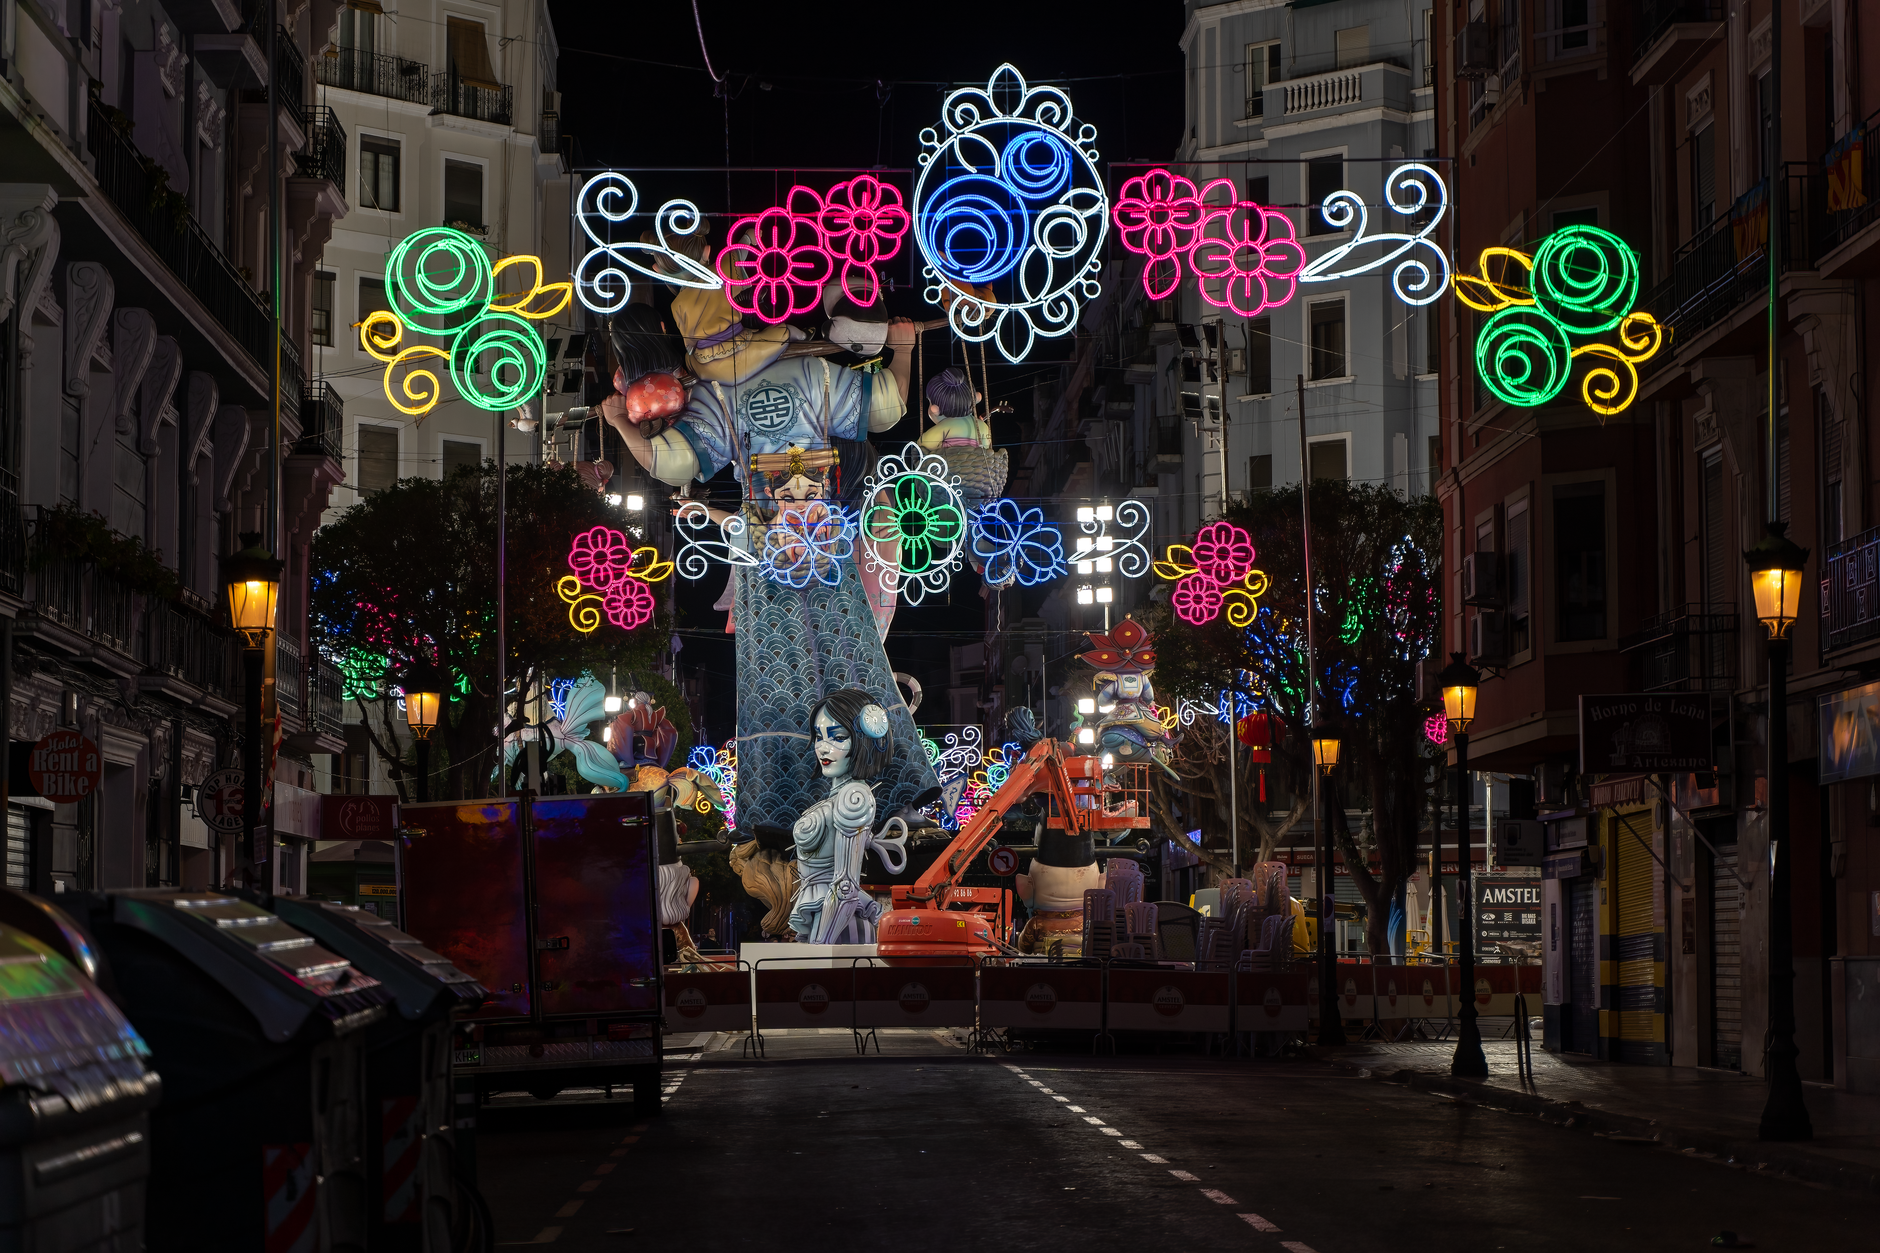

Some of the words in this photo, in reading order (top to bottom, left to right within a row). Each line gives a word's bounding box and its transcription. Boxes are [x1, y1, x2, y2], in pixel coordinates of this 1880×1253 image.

[1590, 702, 1637, 721] Horno
[1645, 698, 1661, 712] de
[43, 736, 83, 752] Hola!
[33, 749, 79, 772] Rent
[85, 752, 98, 772] a
[1632, 755, 1706, 769] Artesano
[42, 772, 89, 796] Bike
[204, 778, 221, 800] HOP
[225, 774, 245, 788] HOU
[209, 788, 245, 816] 13
[356, 814, 380, 823] pollos
[356, 824, 380, 833] planes
[1482, 888, 1540, 903] AMSTEL
[887, 924, 933, 936] MANITOU
